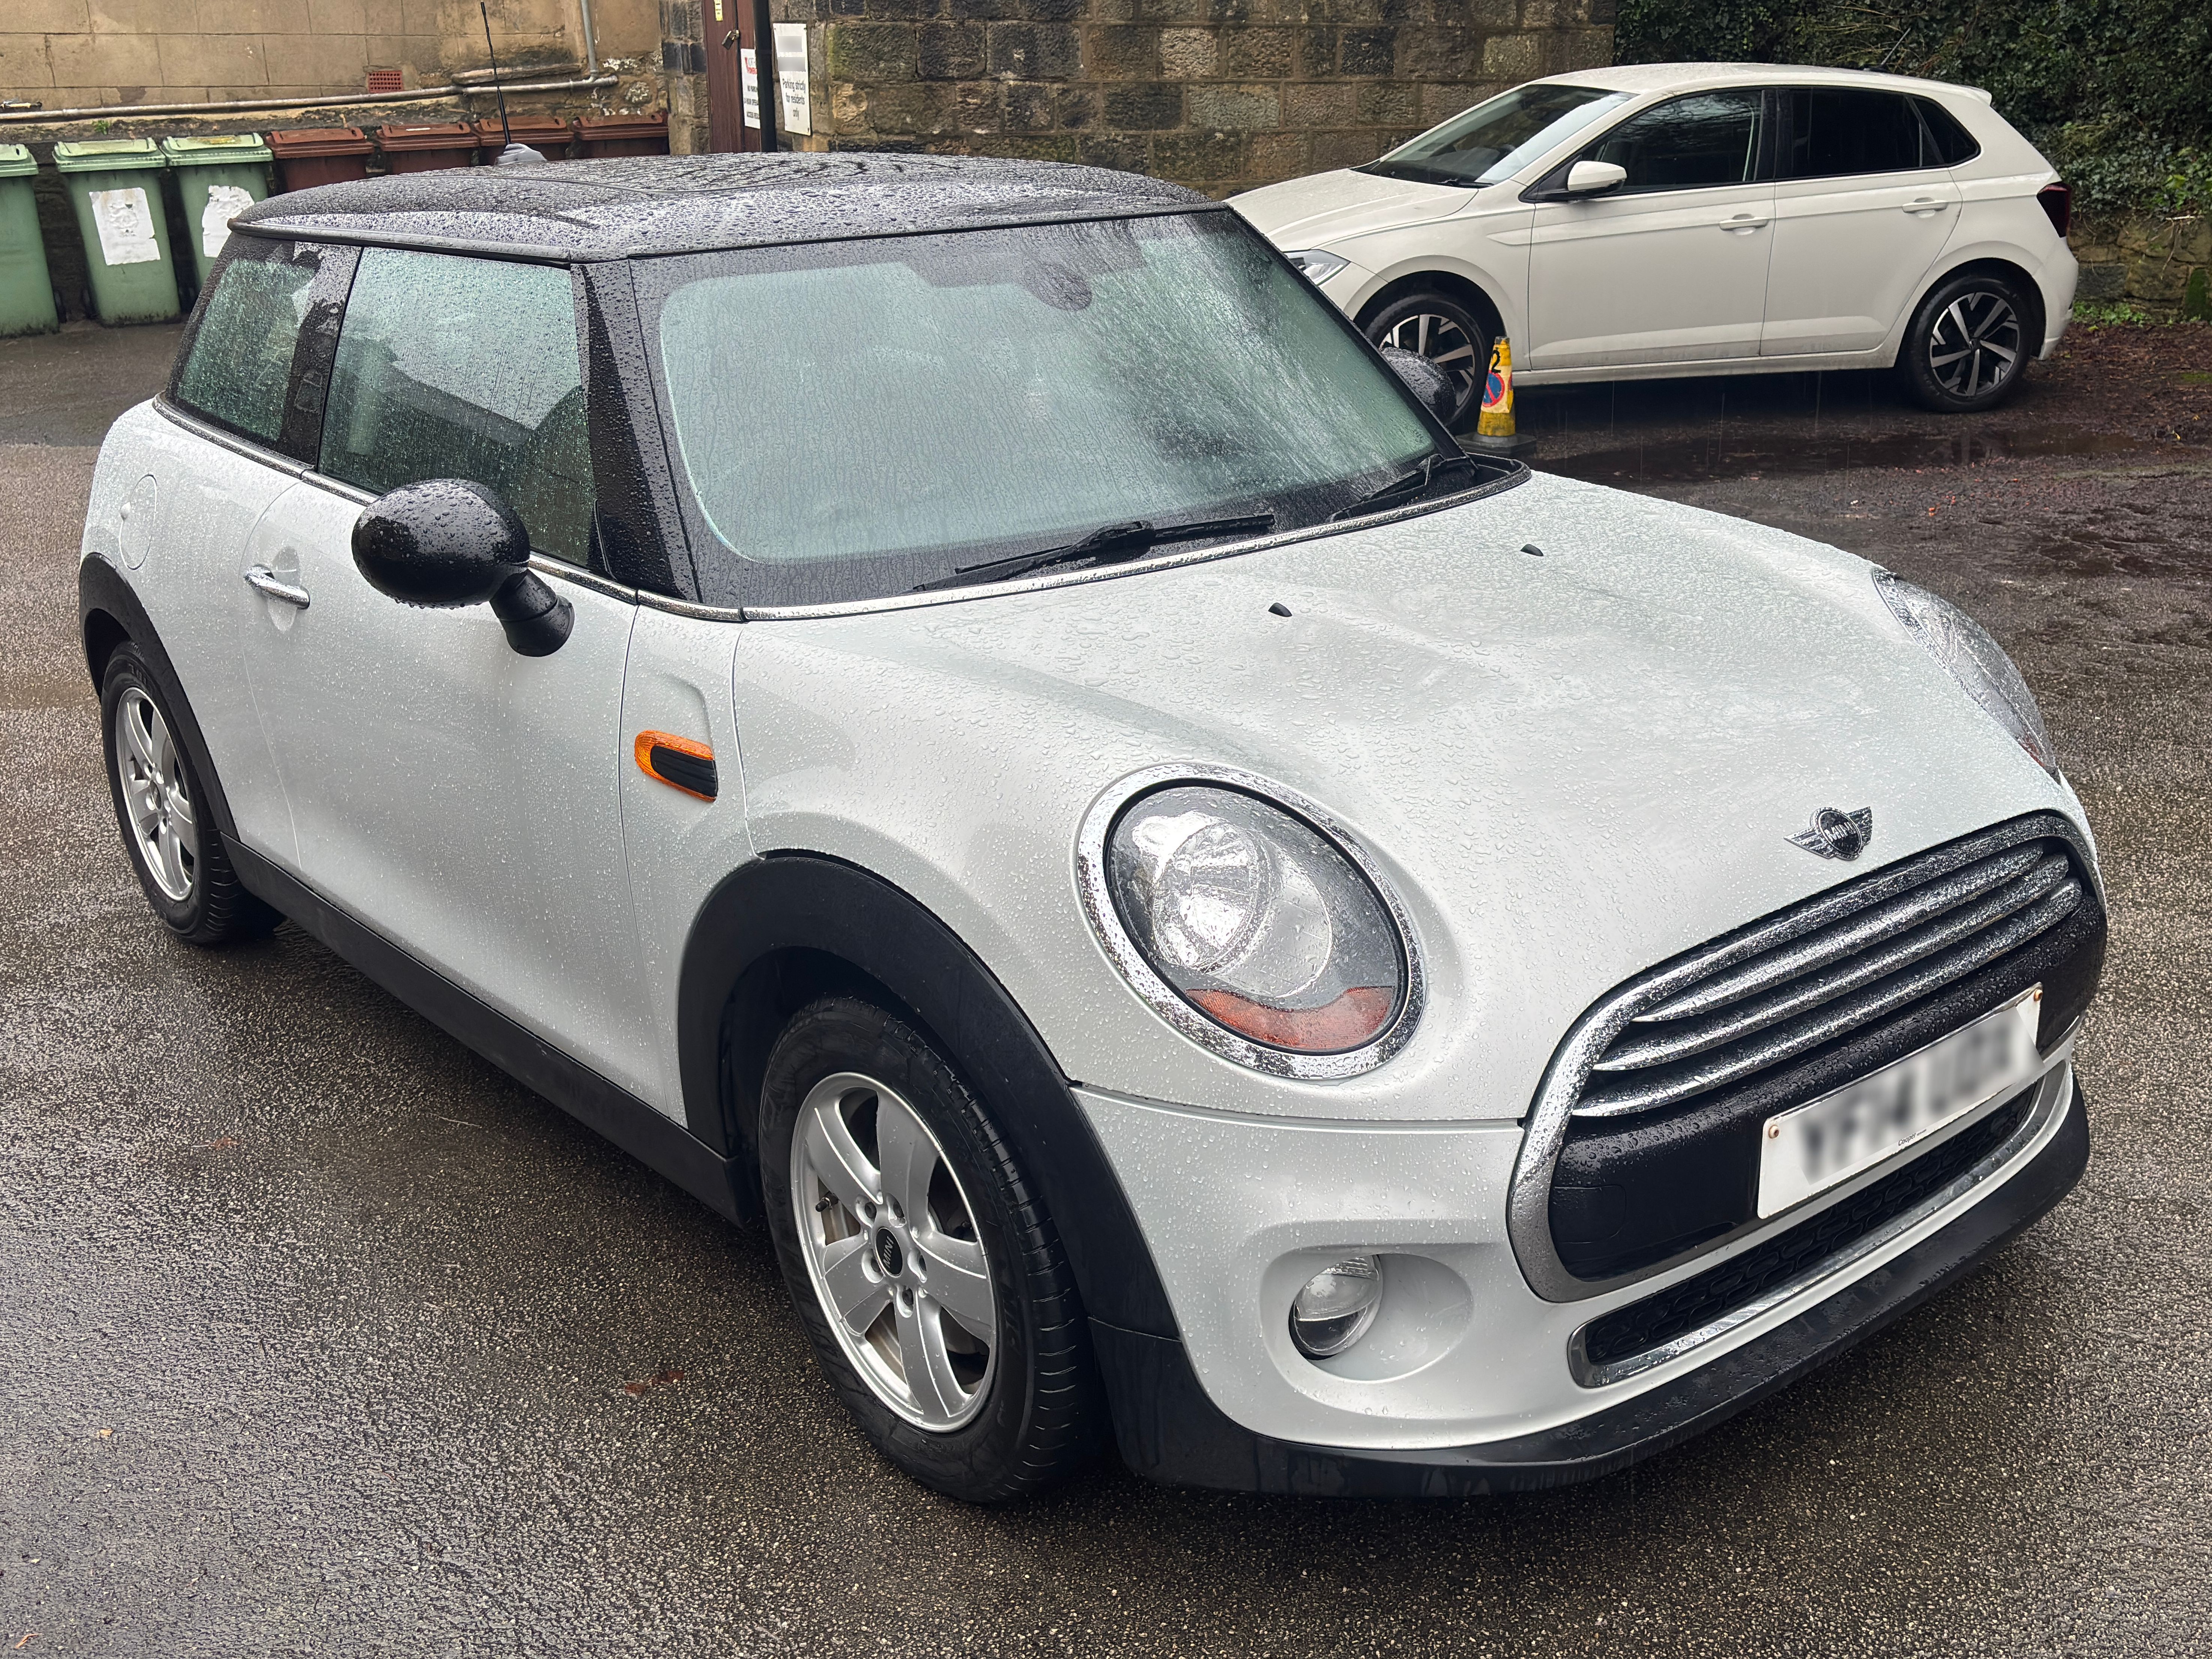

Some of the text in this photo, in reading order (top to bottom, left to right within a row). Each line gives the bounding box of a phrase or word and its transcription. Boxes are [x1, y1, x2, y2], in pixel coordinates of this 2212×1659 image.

[783, 78, 806, 94] Parking strictly
[791, 94, 805, 105] residents
[1491, 350, 1501, 373] 2
[1824, 822, 1856, 842] MINI
[1898, 1133, 1916, 1146] Cooper
[883, 1236, 894, 1268] MINI
